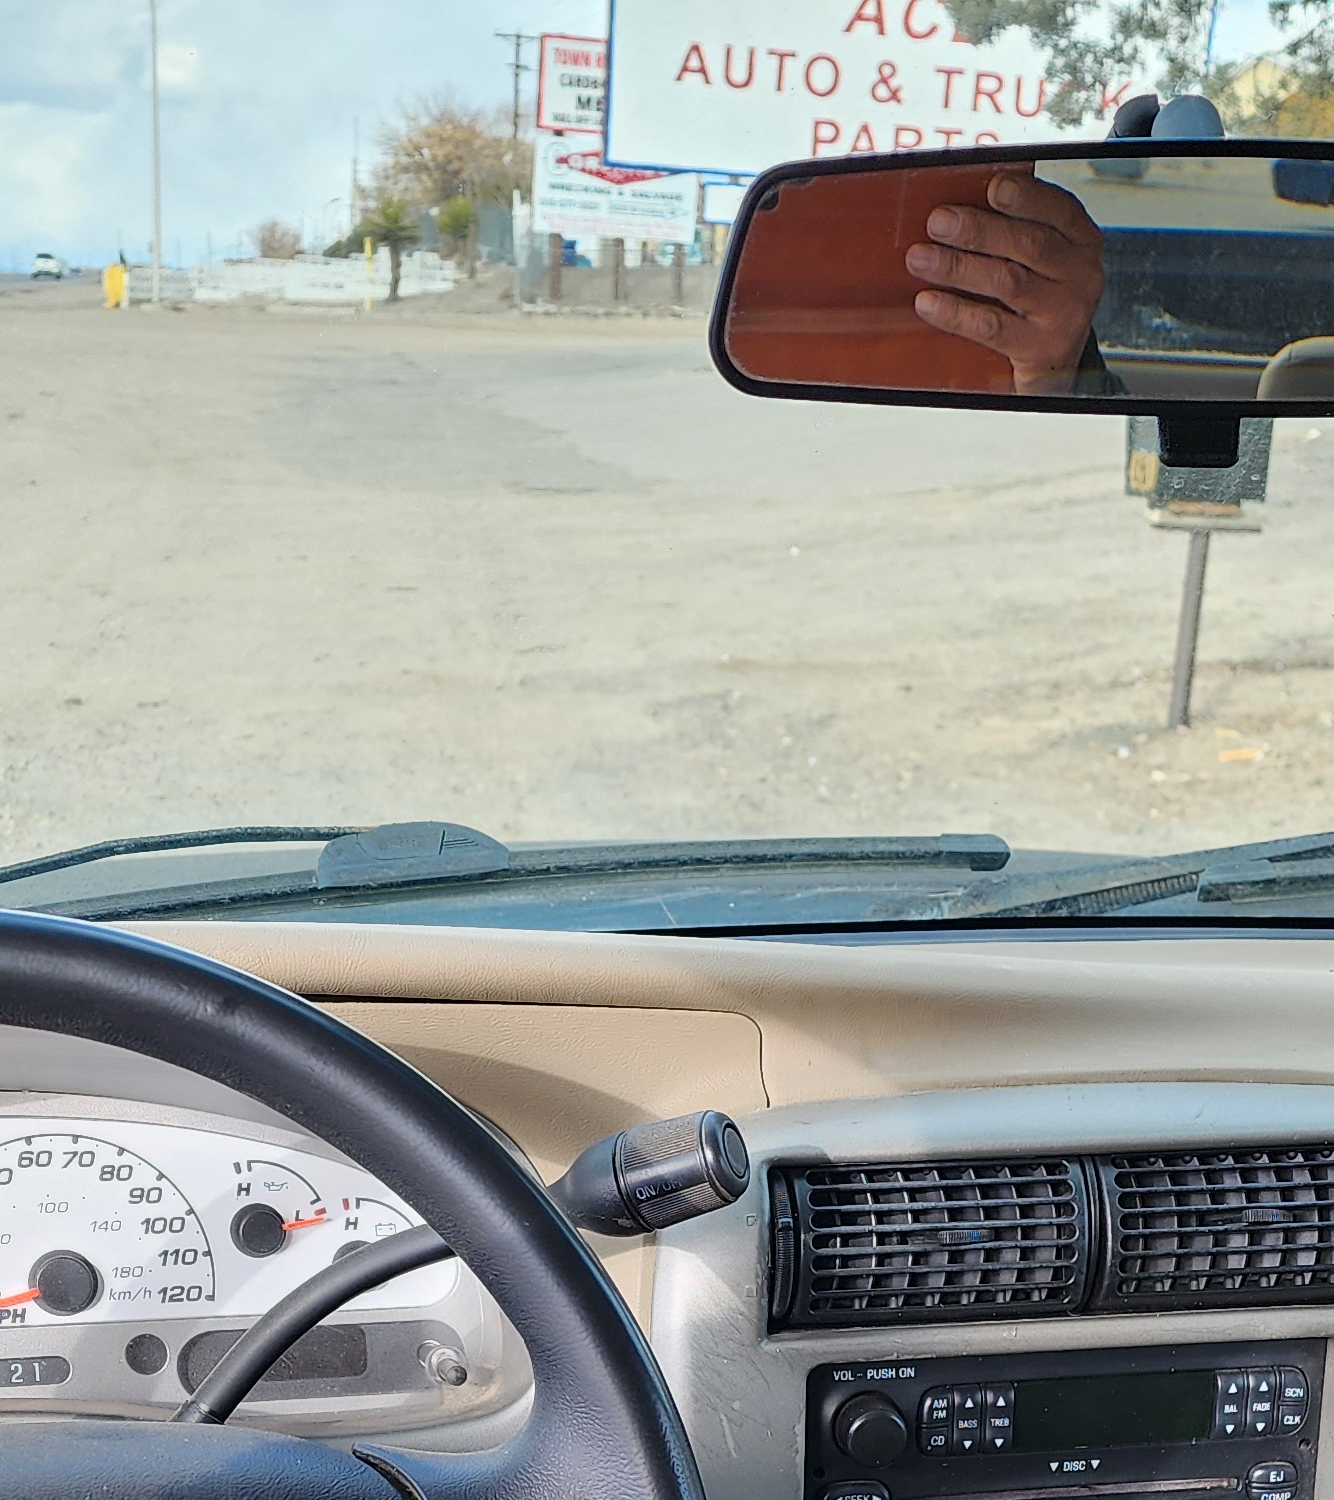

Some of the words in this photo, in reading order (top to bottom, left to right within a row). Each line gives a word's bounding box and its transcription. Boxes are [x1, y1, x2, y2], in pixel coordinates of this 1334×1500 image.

[675, 43, 841, 98] AUTO
[870, 59, 903, 105] &
[935, 65, 1134, 118] TRUK
[17, 1150, 52, 1168] 60
[61, 1151, 95, 1168] 70
[99, 1165, 133, 1182] 80
[128, 1187, 162, 1204] 90
[237, 1183, 251, 1196] H
[37, 1202, 69, 1214] 100
[90, 1220, 122, 1232] 140
[141, 1217, 185, 1234] 100
[344, 1217, 359, 1230] H
[158, 1248, 198, 1266] 110
[112, 1266, 144, 1278] 180
[109, 1287, 152, 1301] km/h
[157, 1286, 202, 1303] 120
[10, 1363, 24, 1383] 2
[32, 1362, 41, 1382] 1
[833, 1370, 854, 1381] VOL
[867, 1368, 896, 1380] PUSH
[899, 1367, 915, 1378] ON
[1285, 1388, 1304, 1397] SCN
[933, 1399, 947, 1408] AM
[1224, 1404, 1238, 1414] BAL
[1253, 1402, 1271, 1412] FADE
[933, 1410, 947, 1419] FM
[1284, 1415, 1301, 1425] CLK
[958, 1419, 978, 1429] BASS
[990, 1418, 1009, 1427] TREB
[931, 1435, 945, 1446] CD
[1063, 1460, 1086, 1472] DISC
[1269, 1471, 1284, 1482] EJ
